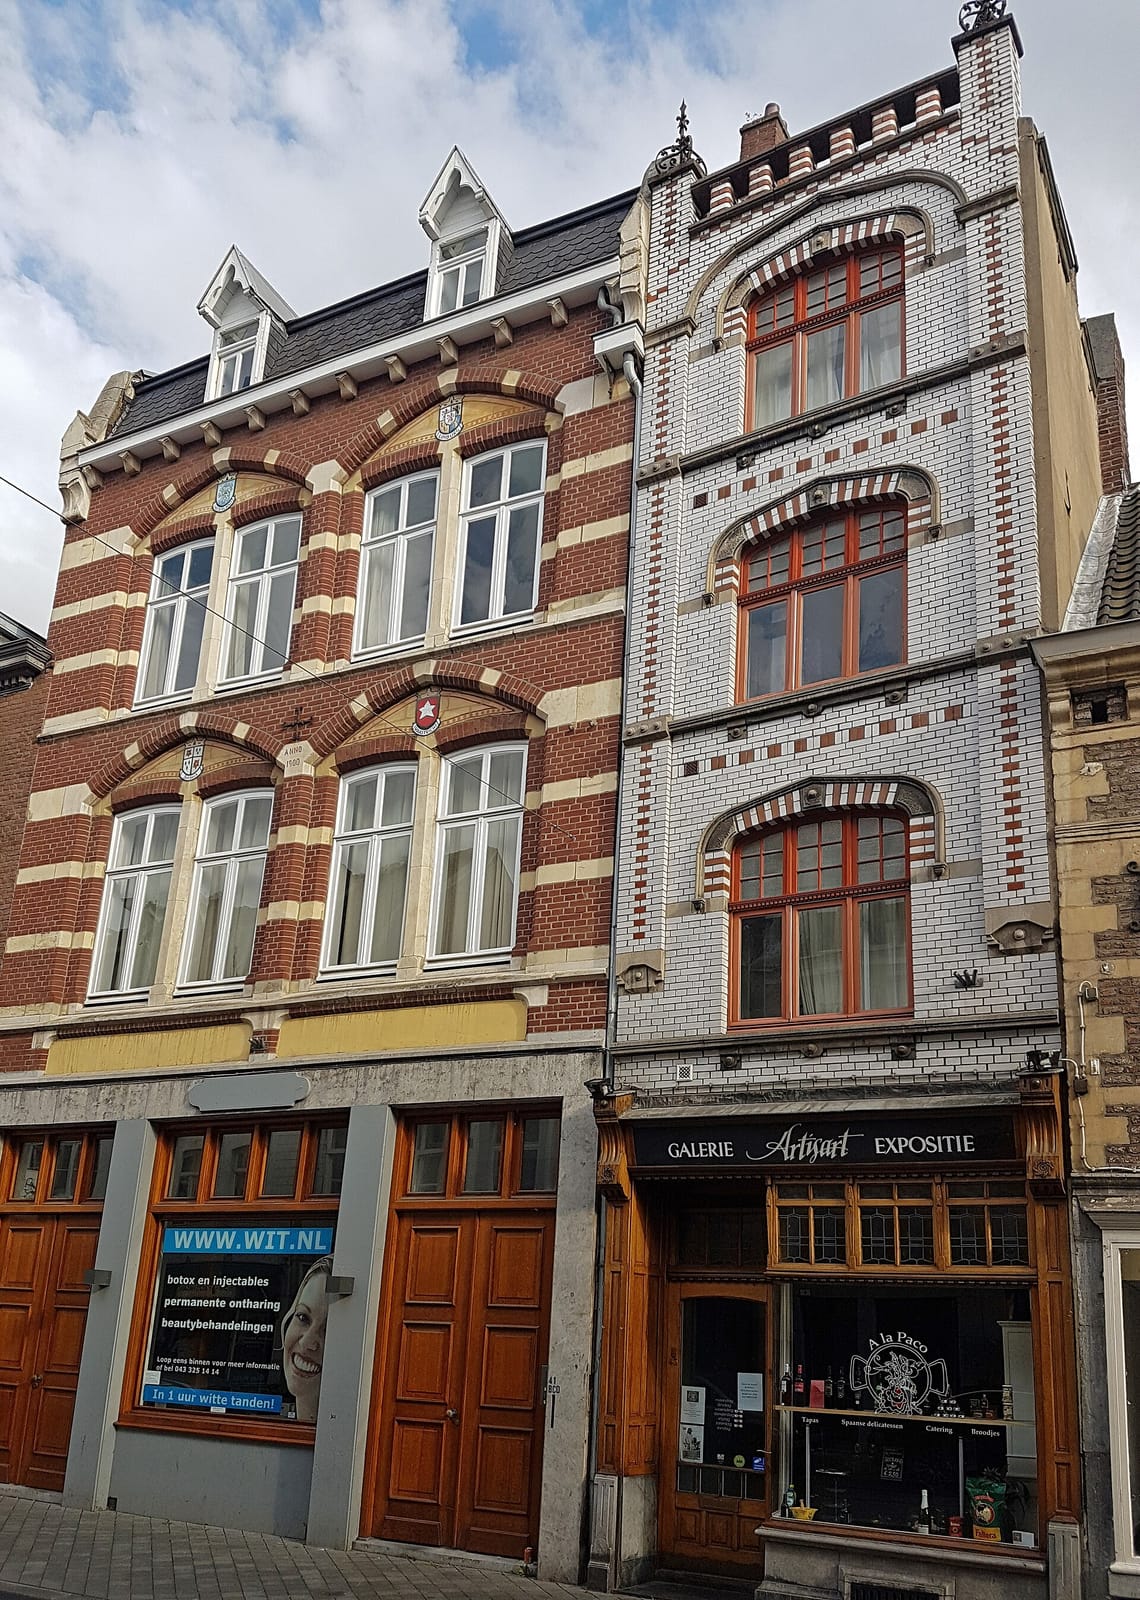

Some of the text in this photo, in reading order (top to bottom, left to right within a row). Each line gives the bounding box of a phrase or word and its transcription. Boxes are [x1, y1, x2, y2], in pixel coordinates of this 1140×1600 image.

[284, 746, 302, 756] ANNO
[668, 1141, 734, 1158] GALERIE
[874, 1134, 976, 1154] EXPOSITIE
[174, 1230, 326, 1250] WWW.WIT.NL
[167, 1275, 269, 1287] botox en injectables
[164, 1298, 281, 1312] permanente ontharing
[161, 1318, 274, 1333] beautybehandelingen
[868, 1331, 928, 1354] A la Paco
[156, 1356, 172, 1365] Loop
[189, 1357, 211, 1366] binnen
[246, 1361, 280, 1371] informatie
[163, 1364, 174, 1372] bel
[152, 1389, 275, 1409] In 1 uur witte tanden!
[802, 1416, 819, 1424] Tapas
[841, 1418, 904, 1430] Spaanse delicatessen
[925, 1425, 953, 1435] Catering
[971, 1428, 1000, 1437] Broodjes
